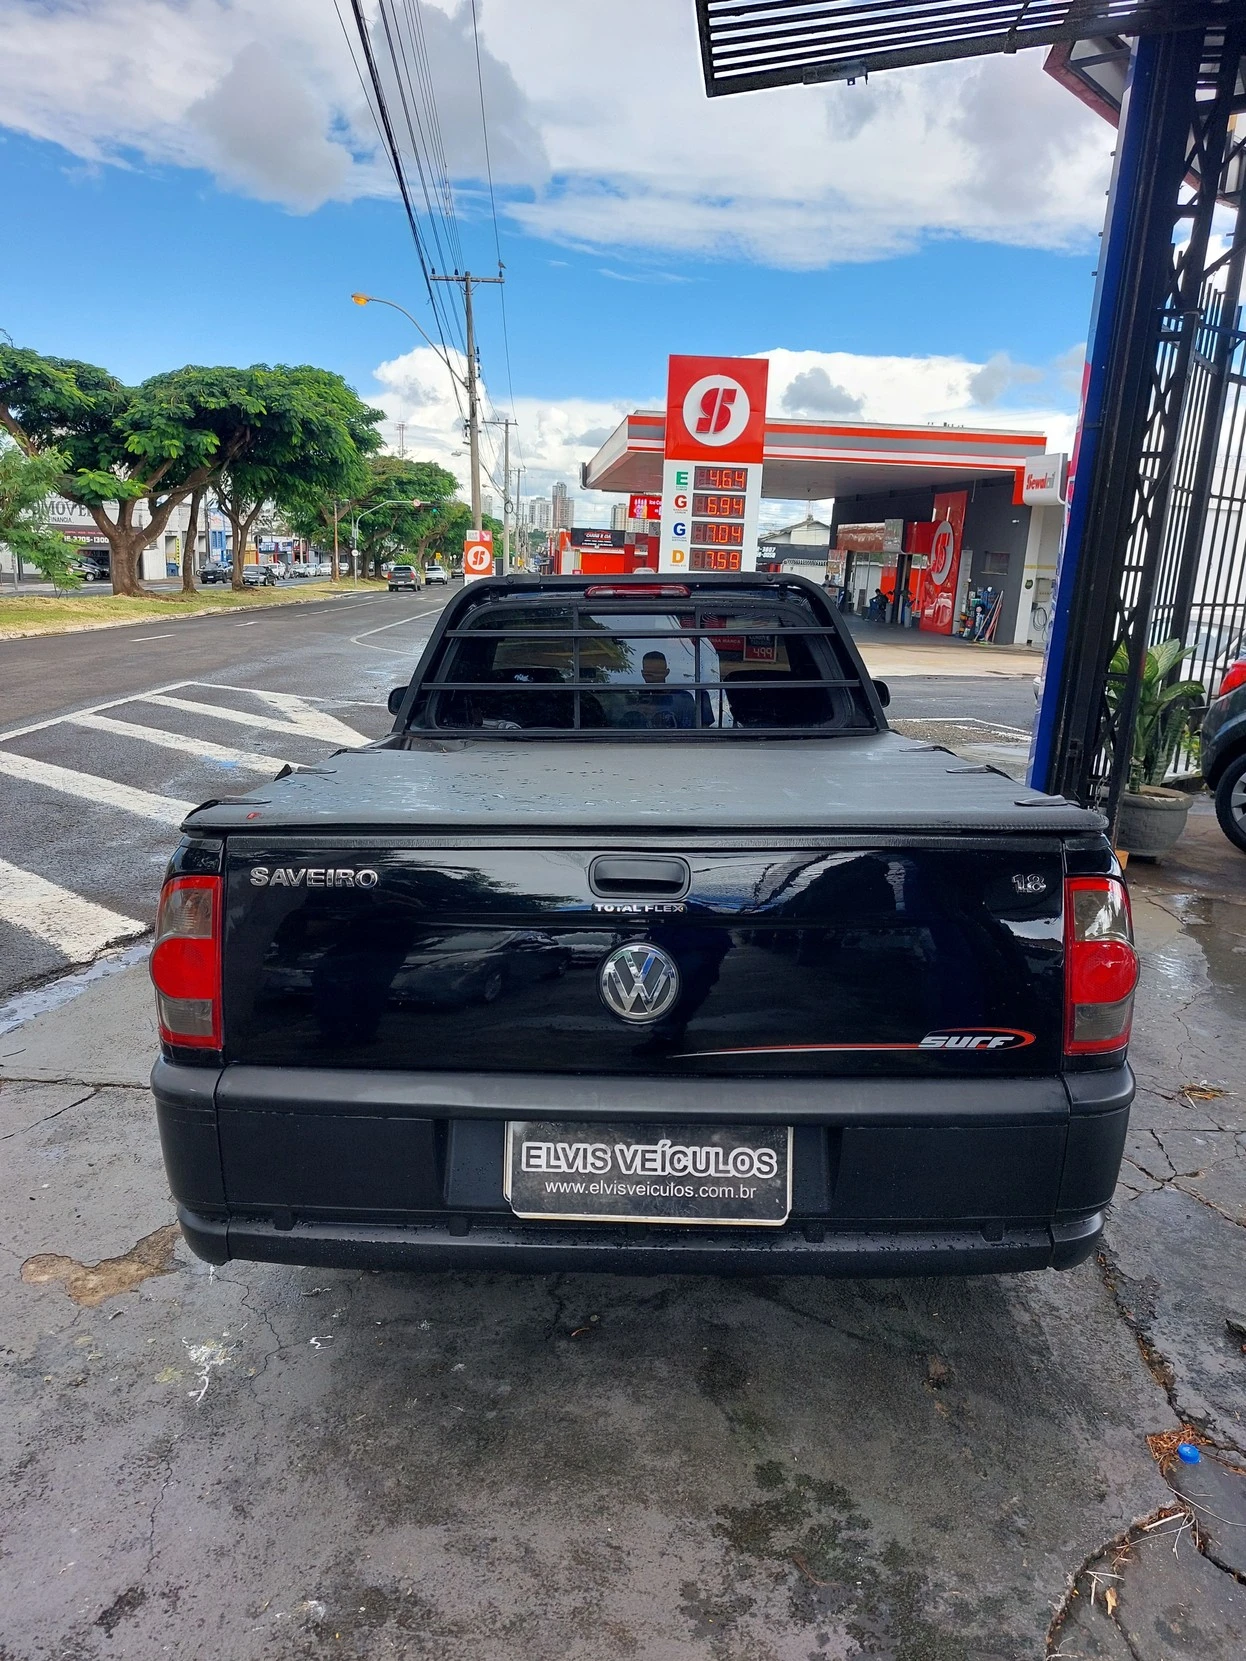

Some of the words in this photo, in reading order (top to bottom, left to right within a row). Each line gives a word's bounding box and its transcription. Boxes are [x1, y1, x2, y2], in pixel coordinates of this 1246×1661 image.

[676, 471, 688, 485] E
[674, 494, 687, 509] G
[673, 522, 686, 536] G
[672, 550, 685, 564] D
[250, 867, 378, 888] SAVEIRO
[595, 904, 641, 913] TOTAL
[644, 904, 684, 913] FLEX
[522, 1141, 612, 1172] ELVIS
[615, 1139, 777, 1178] VEÍCULOS
[545, 1179, 757, 1199] www.elvisveiculos.com.br
